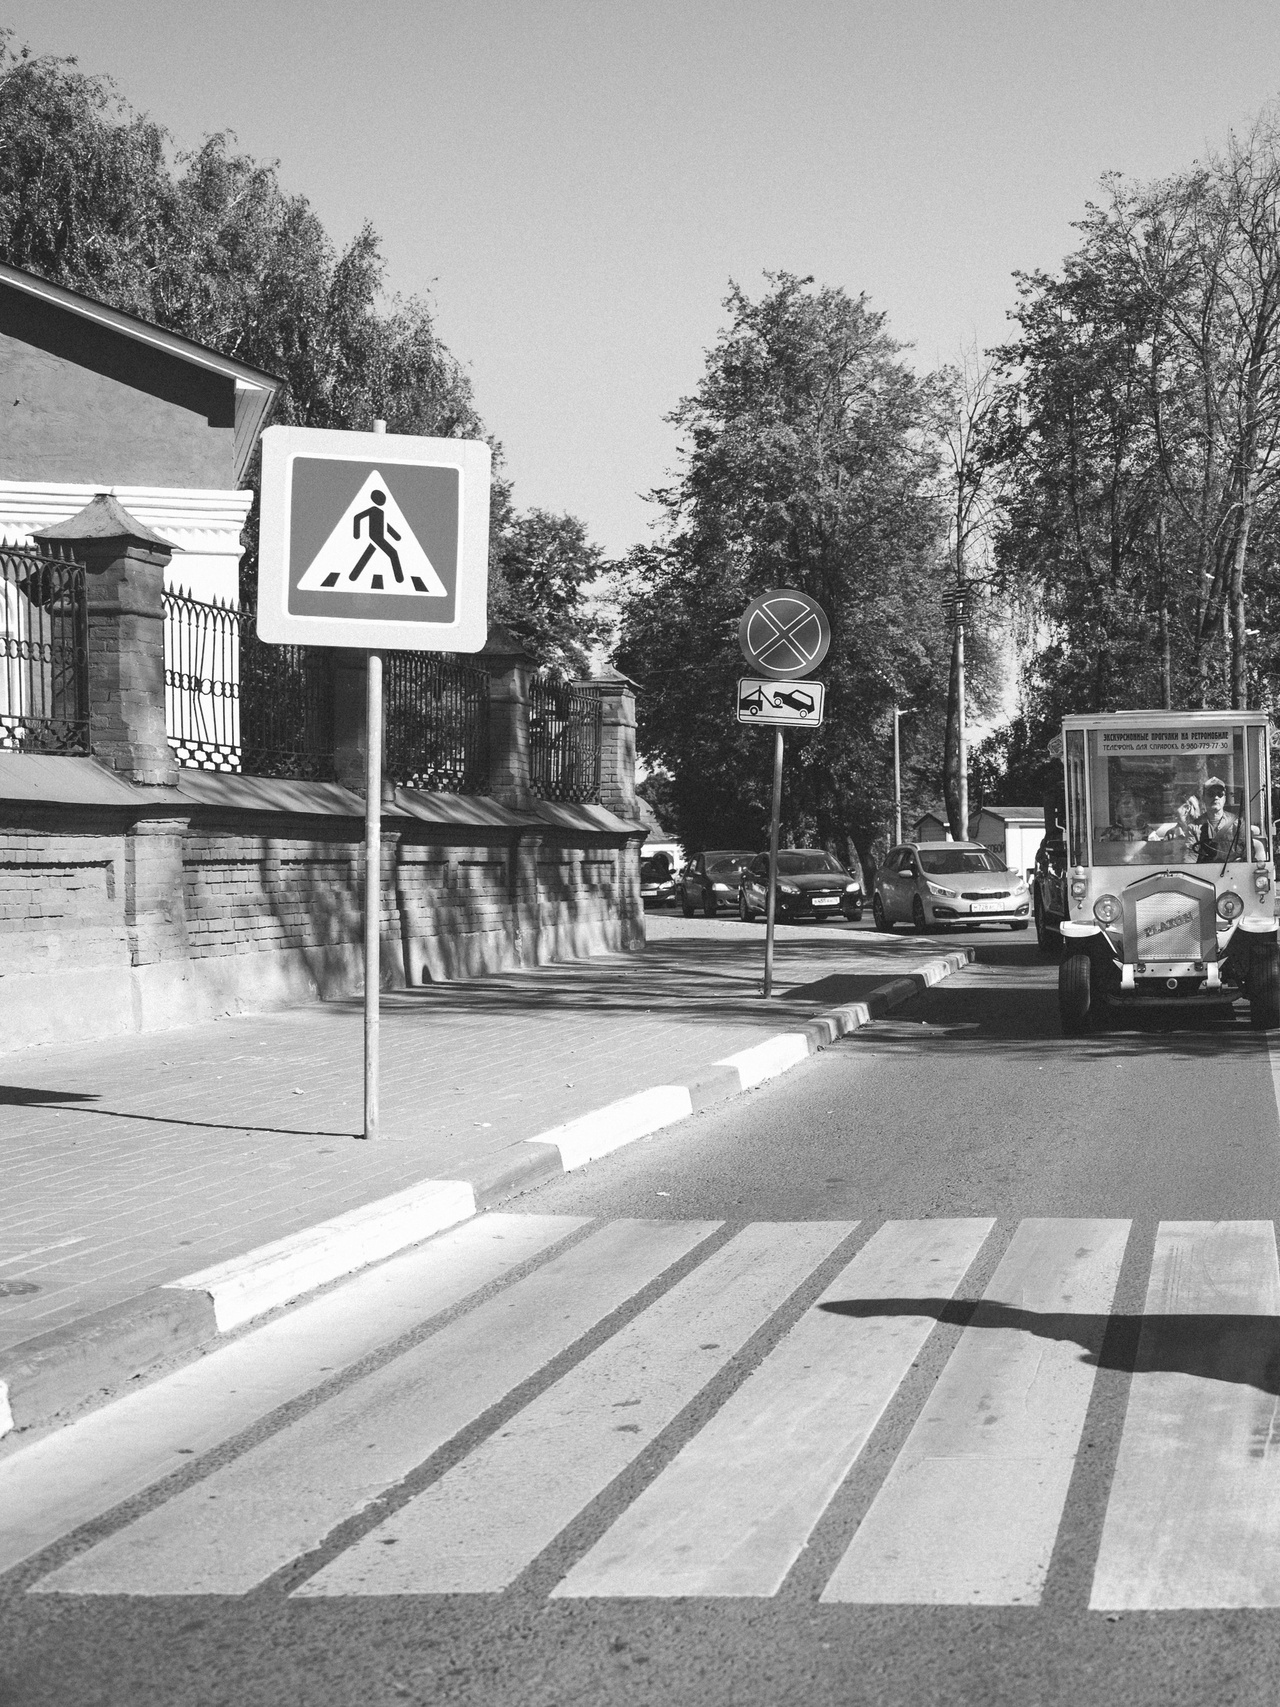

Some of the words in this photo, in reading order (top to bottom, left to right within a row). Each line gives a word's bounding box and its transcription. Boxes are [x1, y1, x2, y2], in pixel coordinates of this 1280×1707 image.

[1103, 733, 1149, 742] ЭКСКУРСИОННЫЕ
[1151, 732, 1179, 741] ПРОГУЛКИ
[1181, 732, 1189, 741] НА
[1191, 731, 1229, 740] РЕТРОМОБИЛЕ
[1136, 743, 1148, 751] ДЛЯ
